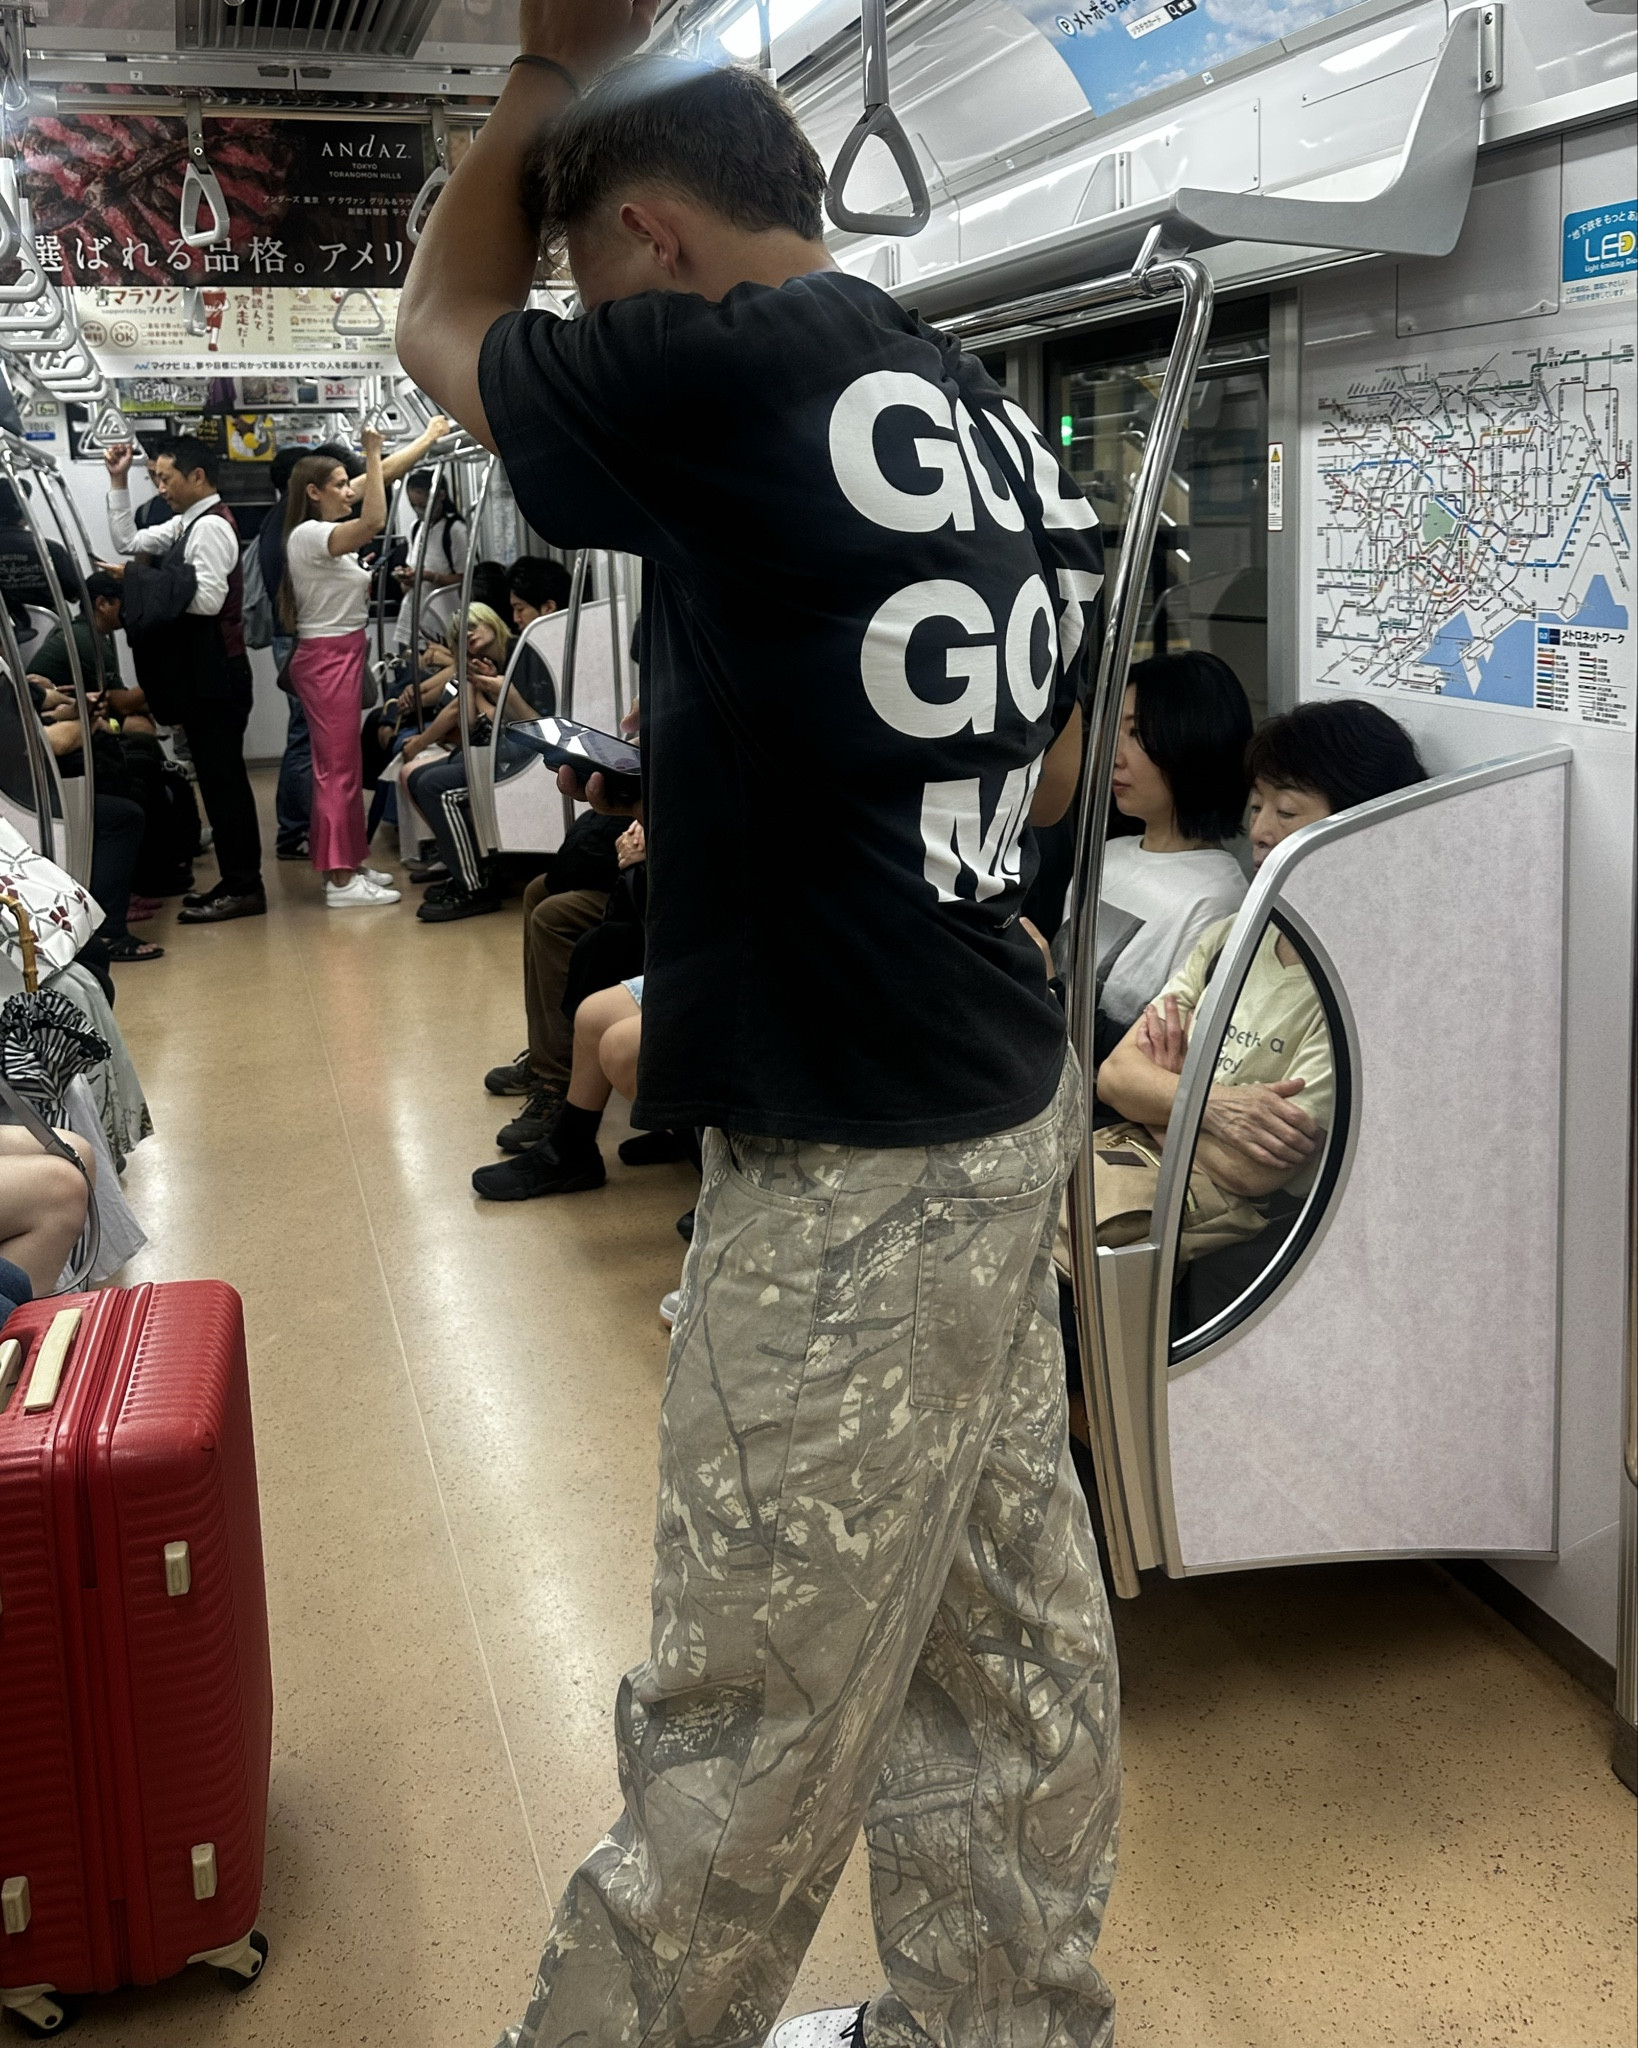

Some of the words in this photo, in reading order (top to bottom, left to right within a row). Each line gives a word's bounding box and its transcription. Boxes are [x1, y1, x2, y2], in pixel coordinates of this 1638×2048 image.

[352, 162, 378, 170] TOKYO
[329, 171, 379, 179] TORANOMON
[1585, 231, 1635, 262] LED
[1584, 263, 1600, 273] Light
[115, 332, 134, 342] OK
[1562, 629, 1625, 644] メトロネットワーク
[1270, 1037, 1285, 1054] a
